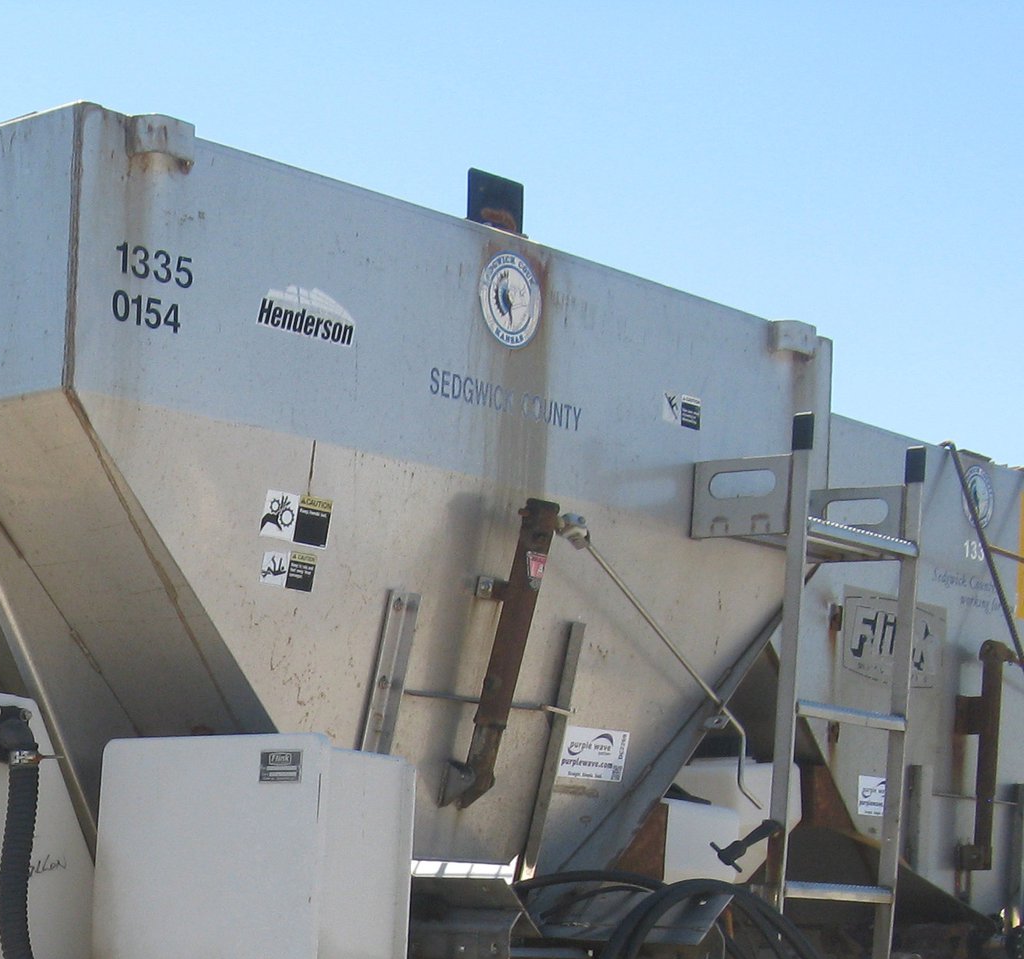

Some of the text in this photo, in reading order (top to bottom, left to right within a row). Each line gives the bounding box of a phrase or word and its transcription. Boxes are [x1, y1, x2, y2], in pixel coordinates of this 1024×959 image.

[116, 241, 193, 288] 1335
[112, 289, 181, 334] 0154
[257, 298, 355, 346] Henderson
[430, 367, 582, 431] SEDGWICK COUNTY
[561, 757, 614, 769] purplewave.com
